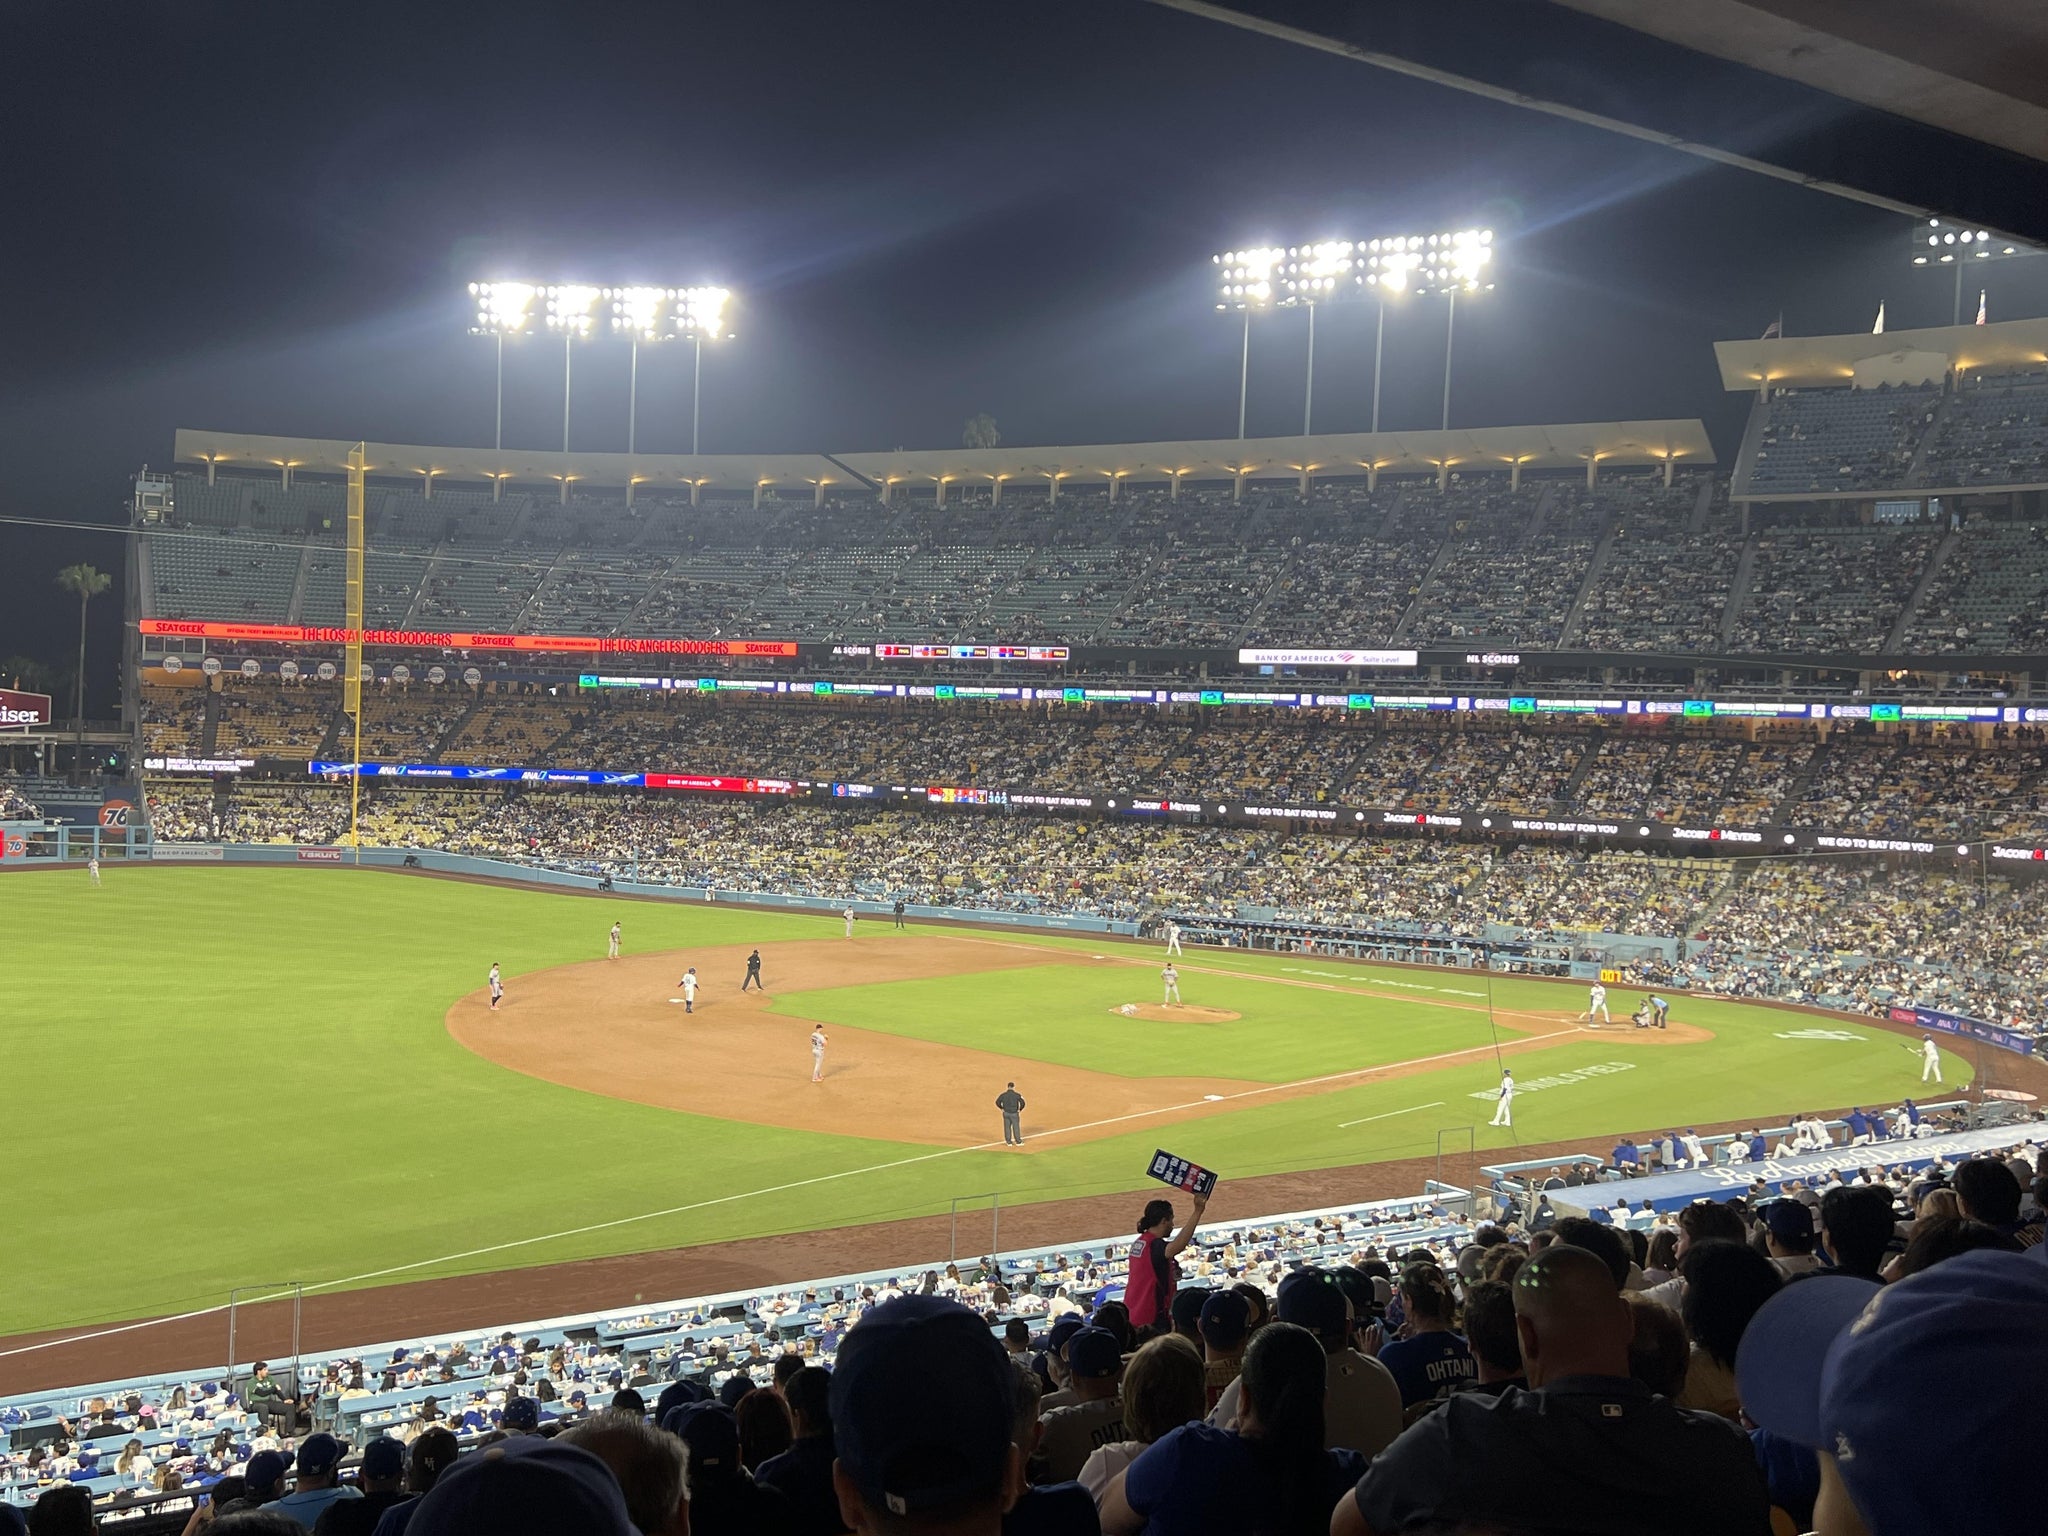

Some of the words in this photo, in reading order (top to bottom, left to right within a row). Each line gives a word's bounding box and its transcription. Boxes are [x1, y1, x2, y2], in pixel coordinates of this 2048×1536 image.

[155, 622, 205, 634] SEATGEEK
[301, 627, 322, 641] THE
[323, 628, 346, 642] LOS
[347, 629, 397, 643] AGELES
[400, 631, 452, 646] DODGERS
[471, 635, 515, 647] SEATGEEK
[599, 639, 617, 652] THE
[617, 639, 637, 653] LOS
[639, 640, 682, 654] ANGELES
[682, 641, 729, 656] DODGERS
[745, 643, 784, 655] SEATGEEK
[832, 646, 842, 654] AL
[843, 646, 871, 655] SCORES
[1254, 654, 1279, 662] BANK
[1293, 655, 1335, 663] AMERICA
[1362, 655, 1381, 663] Suite
[1382, 656, 1400, 664] Level
[1466, 654, 1481, 664] NL
[1482, 654, 1520, 664] SCORES
[378, 766, 397, 775] ANA
[521, 771, 539, 780] ANA
[1011, 795, 1023, 804] WE
[1023, 796, 1035, 804] GO
[1035, 796, 1045, 804] TO
[1045, 797, 1060, 805] BAT
[1061, 797, 1075, 806] FOR
[1076, 798, 1092, 807] YOU
[104, 806, 129, 827] 76
[1244, 806, 1258, 815] WE
[1258, 806, 1271, 816] GO
[1271, 807, 1283, 817] TO
[1284, 808, 1301, 817] BAT
[1301, 809, 1318, 819] FOR
[1318, 810, 1337, 820] YOU
[1512, 820, 1528, 830] WE
[1528, 820, 1543, 830] GO
[1543, 821, 1557, 831] TO
[1557, 822, 1576, 832] BAT
[1577, 823, 1596, 834] FOR
[1596, 824, 1618, 835] YOU
[8, 838, 24, 853] 76
[1817, 836, 1836, 847] WE
[1836, 837, 1852, 847] GO
[1852, 837, 1867, 849] TO
[1868, 839, 1889, 850] BAT
[1889, 840, 1910, 852] FOR
[1911, 842, 1934, 853] YOU
[1701, 1166, 1762, 1187] Los
[1758, 1153, 1862, 1180] Angeles
[1856, 1141, 1968, 1164] Dodgers
[1425, 1358, 1474, 1382] OHTANI
